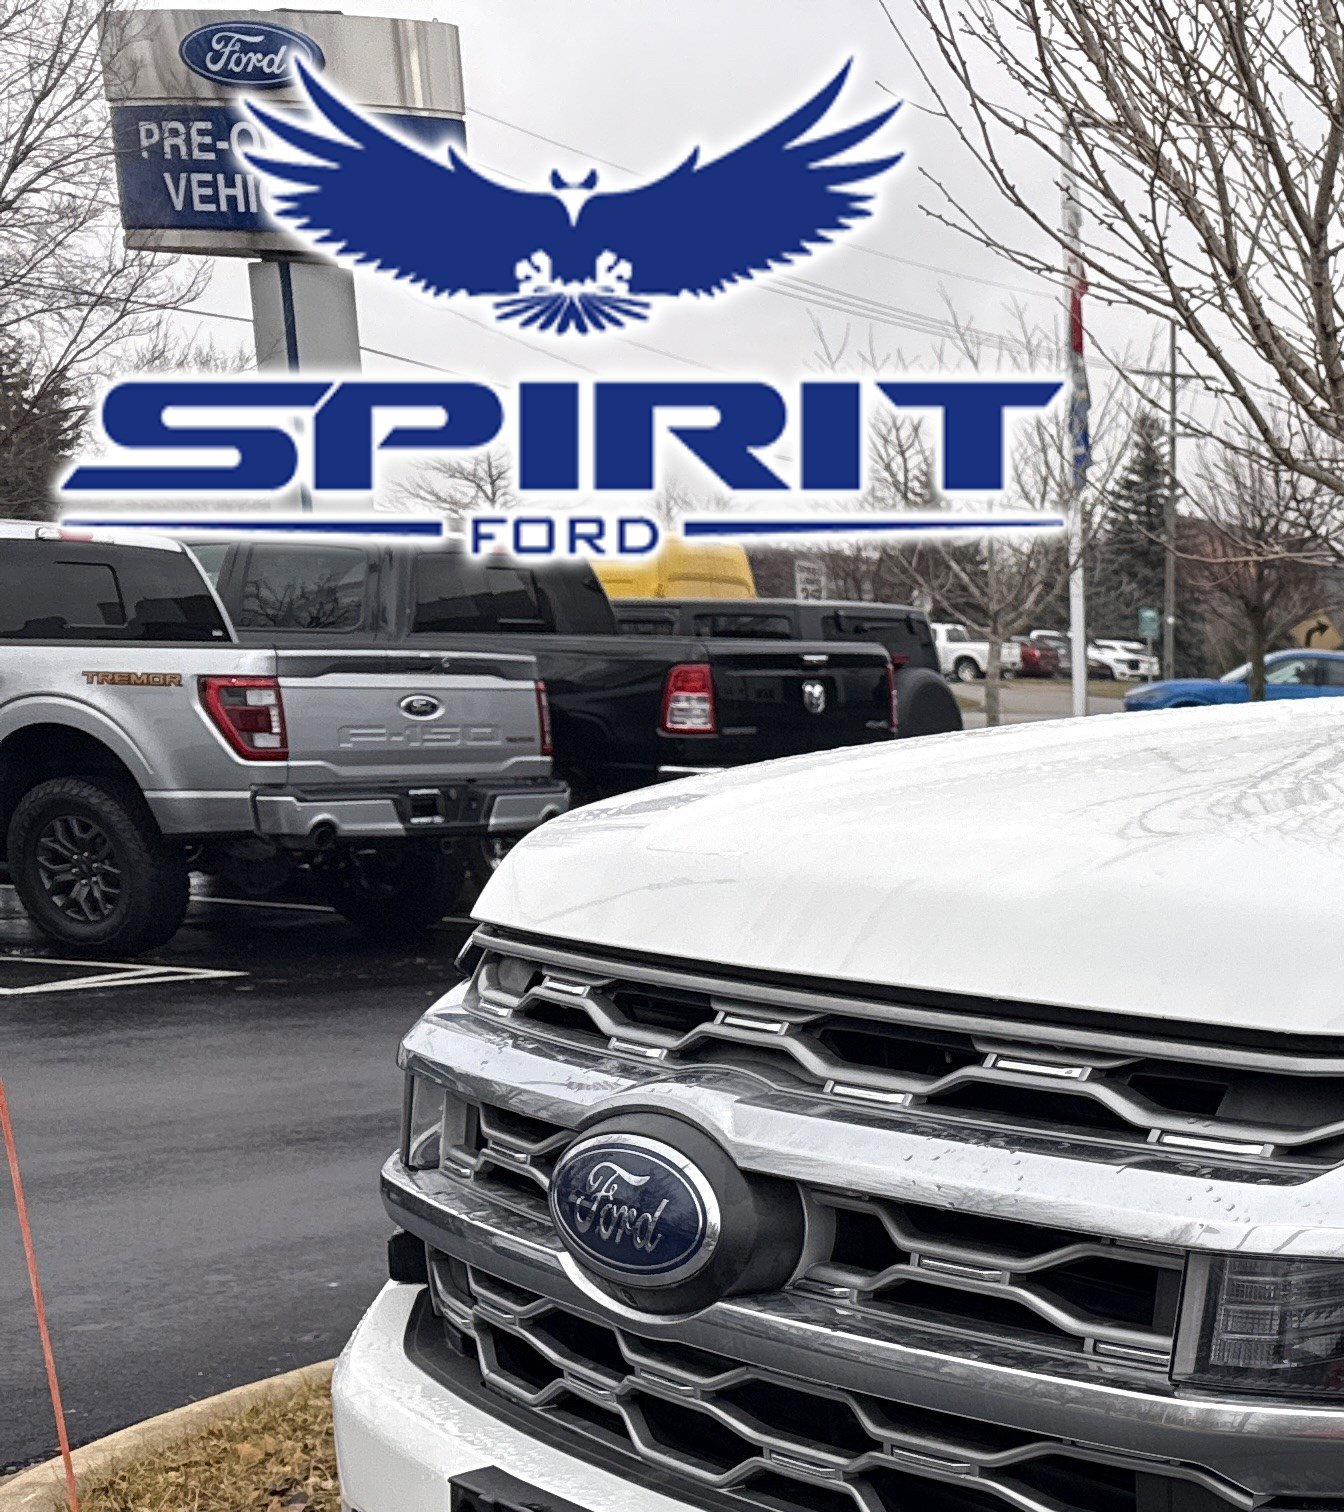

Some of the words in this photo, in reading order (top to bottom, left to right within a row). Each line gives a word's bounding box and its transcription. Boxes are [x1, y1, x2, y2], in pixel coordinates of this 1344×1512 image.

[205, 32, 287, 75] Ford
[138, 120, 263, 161] PRE-O
[163, 172, 262, 213] VEHI
[82, 671, 183, 687] TREMOR
[337, 724, 500, 747] F-150
[574, 1161, 670, 1252] Ford
